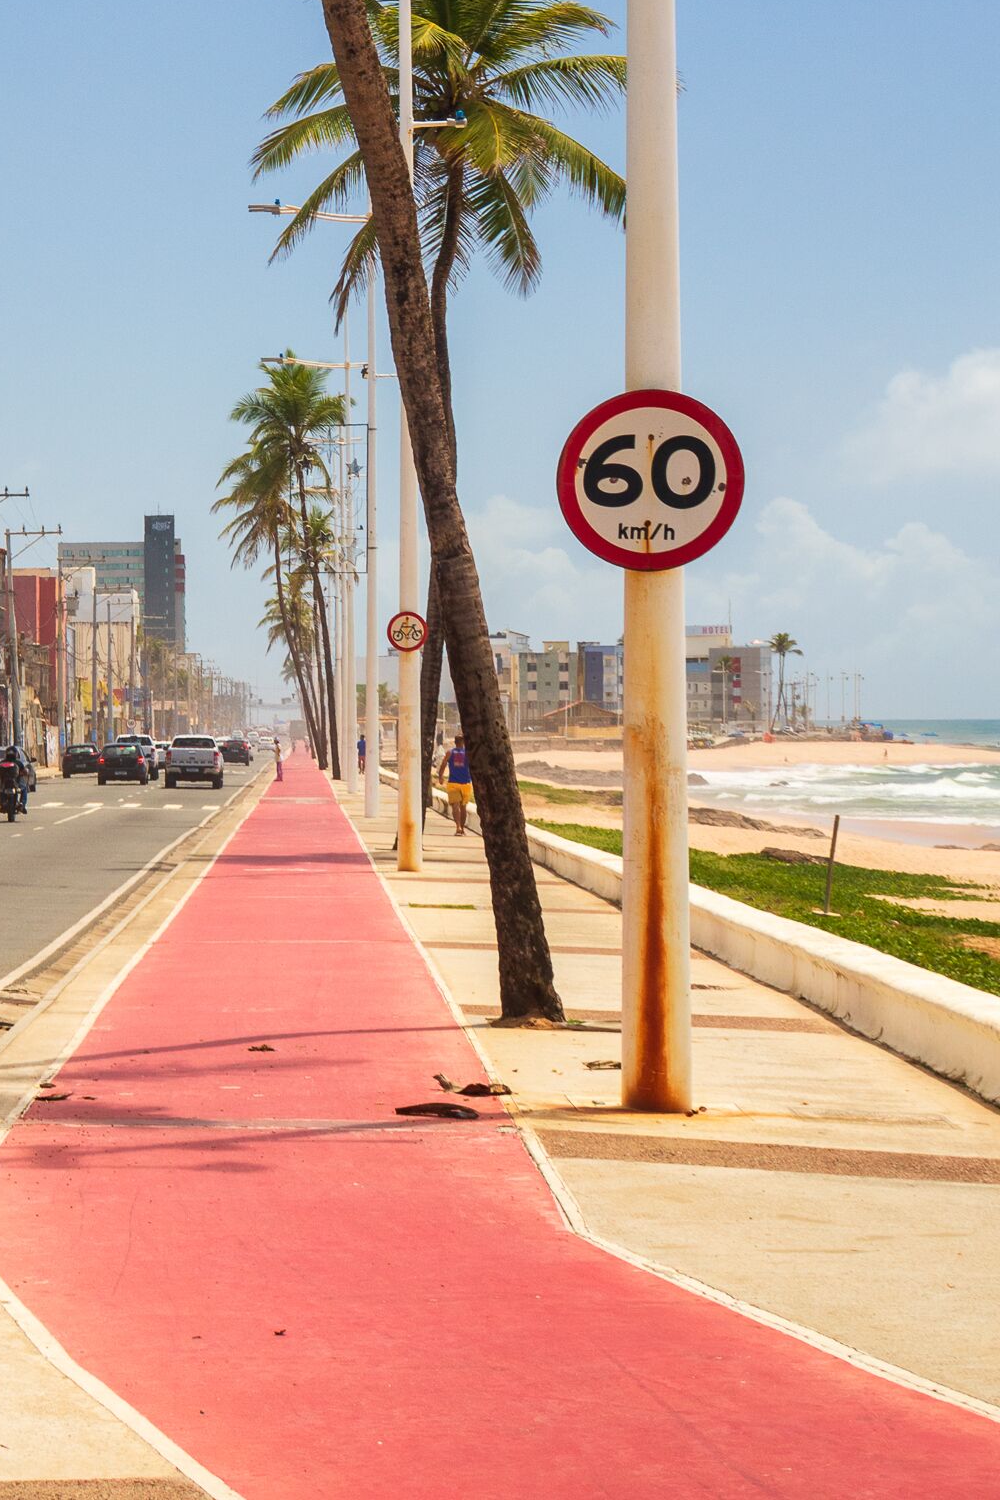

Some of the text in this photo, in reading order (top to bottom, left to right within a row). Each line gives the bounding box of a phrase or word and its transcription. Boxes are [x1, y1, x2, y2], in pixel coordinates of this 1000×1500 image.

[583, 434, 716, 510] 60
[618, 522, 675, 541] km/h
[702, 626, 729, 634] HOTEL
